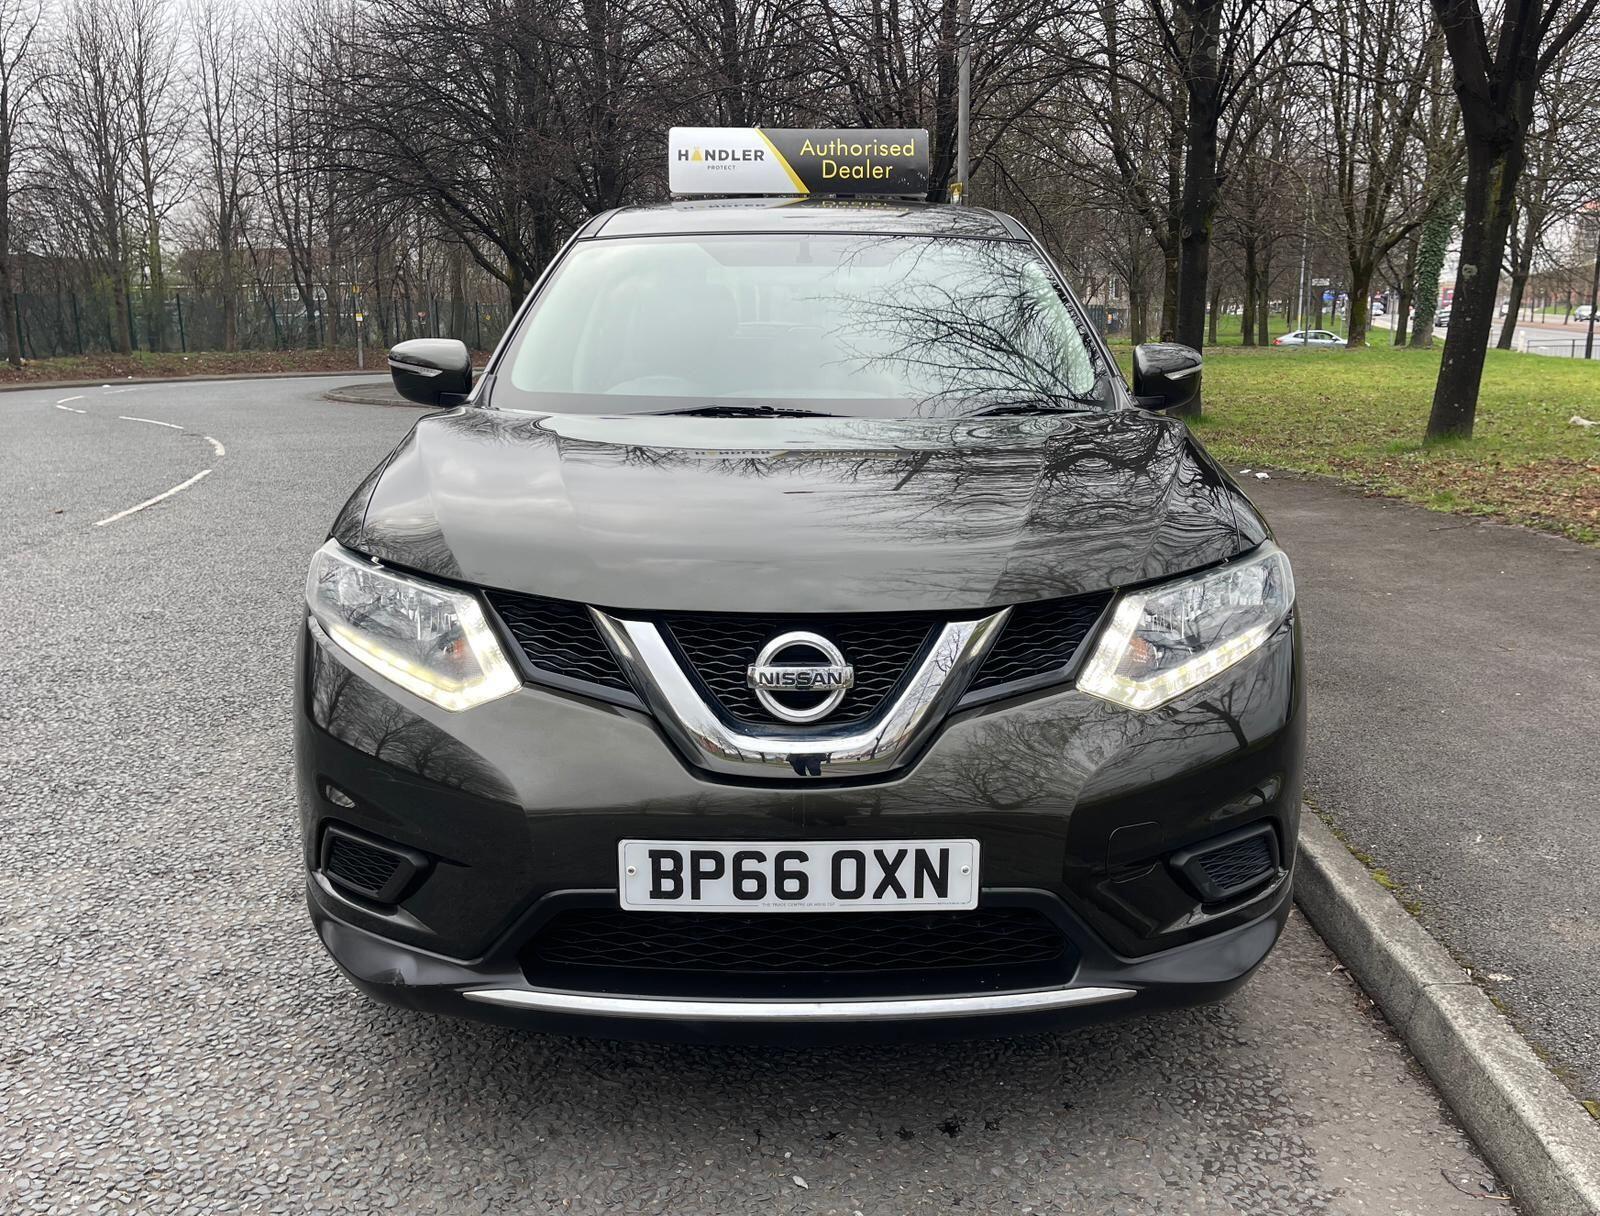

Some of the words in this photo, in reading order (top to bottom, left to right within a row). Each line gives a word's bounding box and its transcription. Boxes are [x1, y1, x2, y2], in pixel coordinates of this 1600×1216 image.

[800, 138, 915, 157] Authorised
[822, 159, 893, 180] Dealer
[758, 672, 842, 686] NISSAN
[648, 849, 809, 901] BP66
[831, 848, 950, 900] OXN
